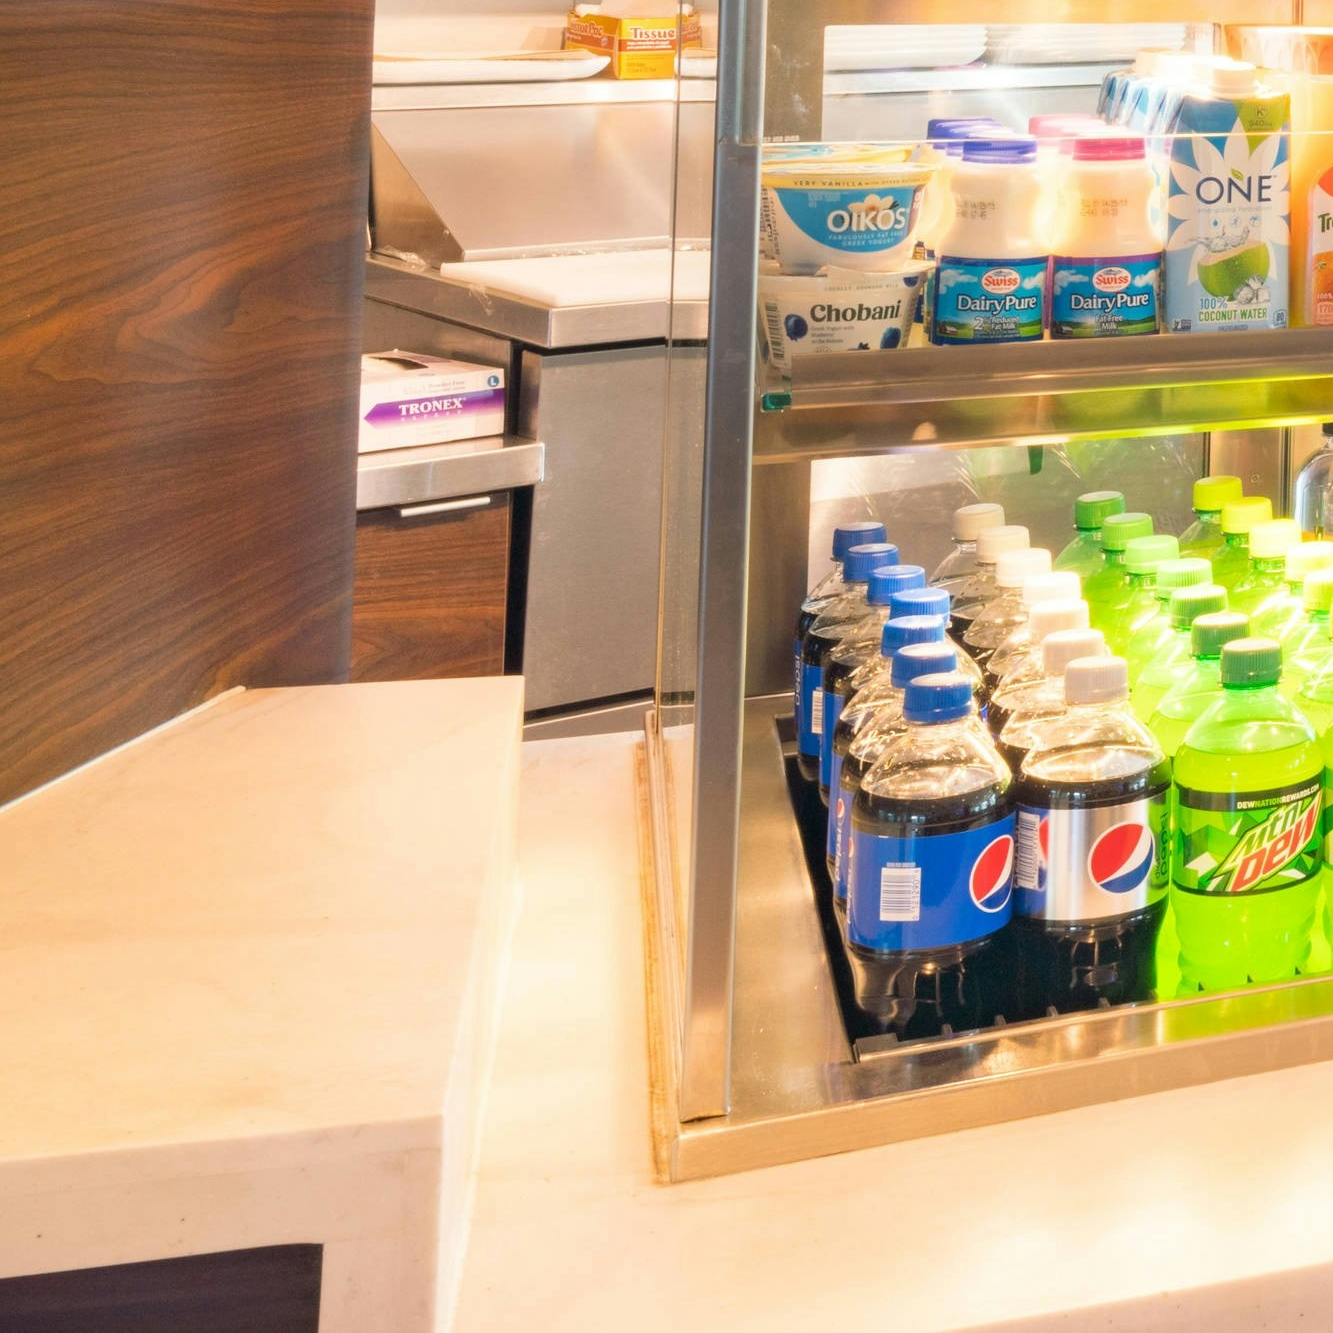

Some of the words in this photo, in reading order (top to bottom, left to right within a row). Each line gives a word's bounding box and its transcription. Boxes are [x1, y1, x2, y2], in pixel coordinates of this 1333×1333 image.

[1196, 175, 1272, 205] ONE
[984, 276, 1018, 288] Swiss
[1095, 274, 1129, 286] Swiss
[1200, 297, 1228, 310] 100%
[811, 300, 901, 322] Chobani
[1198, 309, 1238, 322] COCONUT
[1240, 308, 1267, 320] WATER
[491, 377, 496, 386] L
[399, 397, 462, 416] TRONEX
